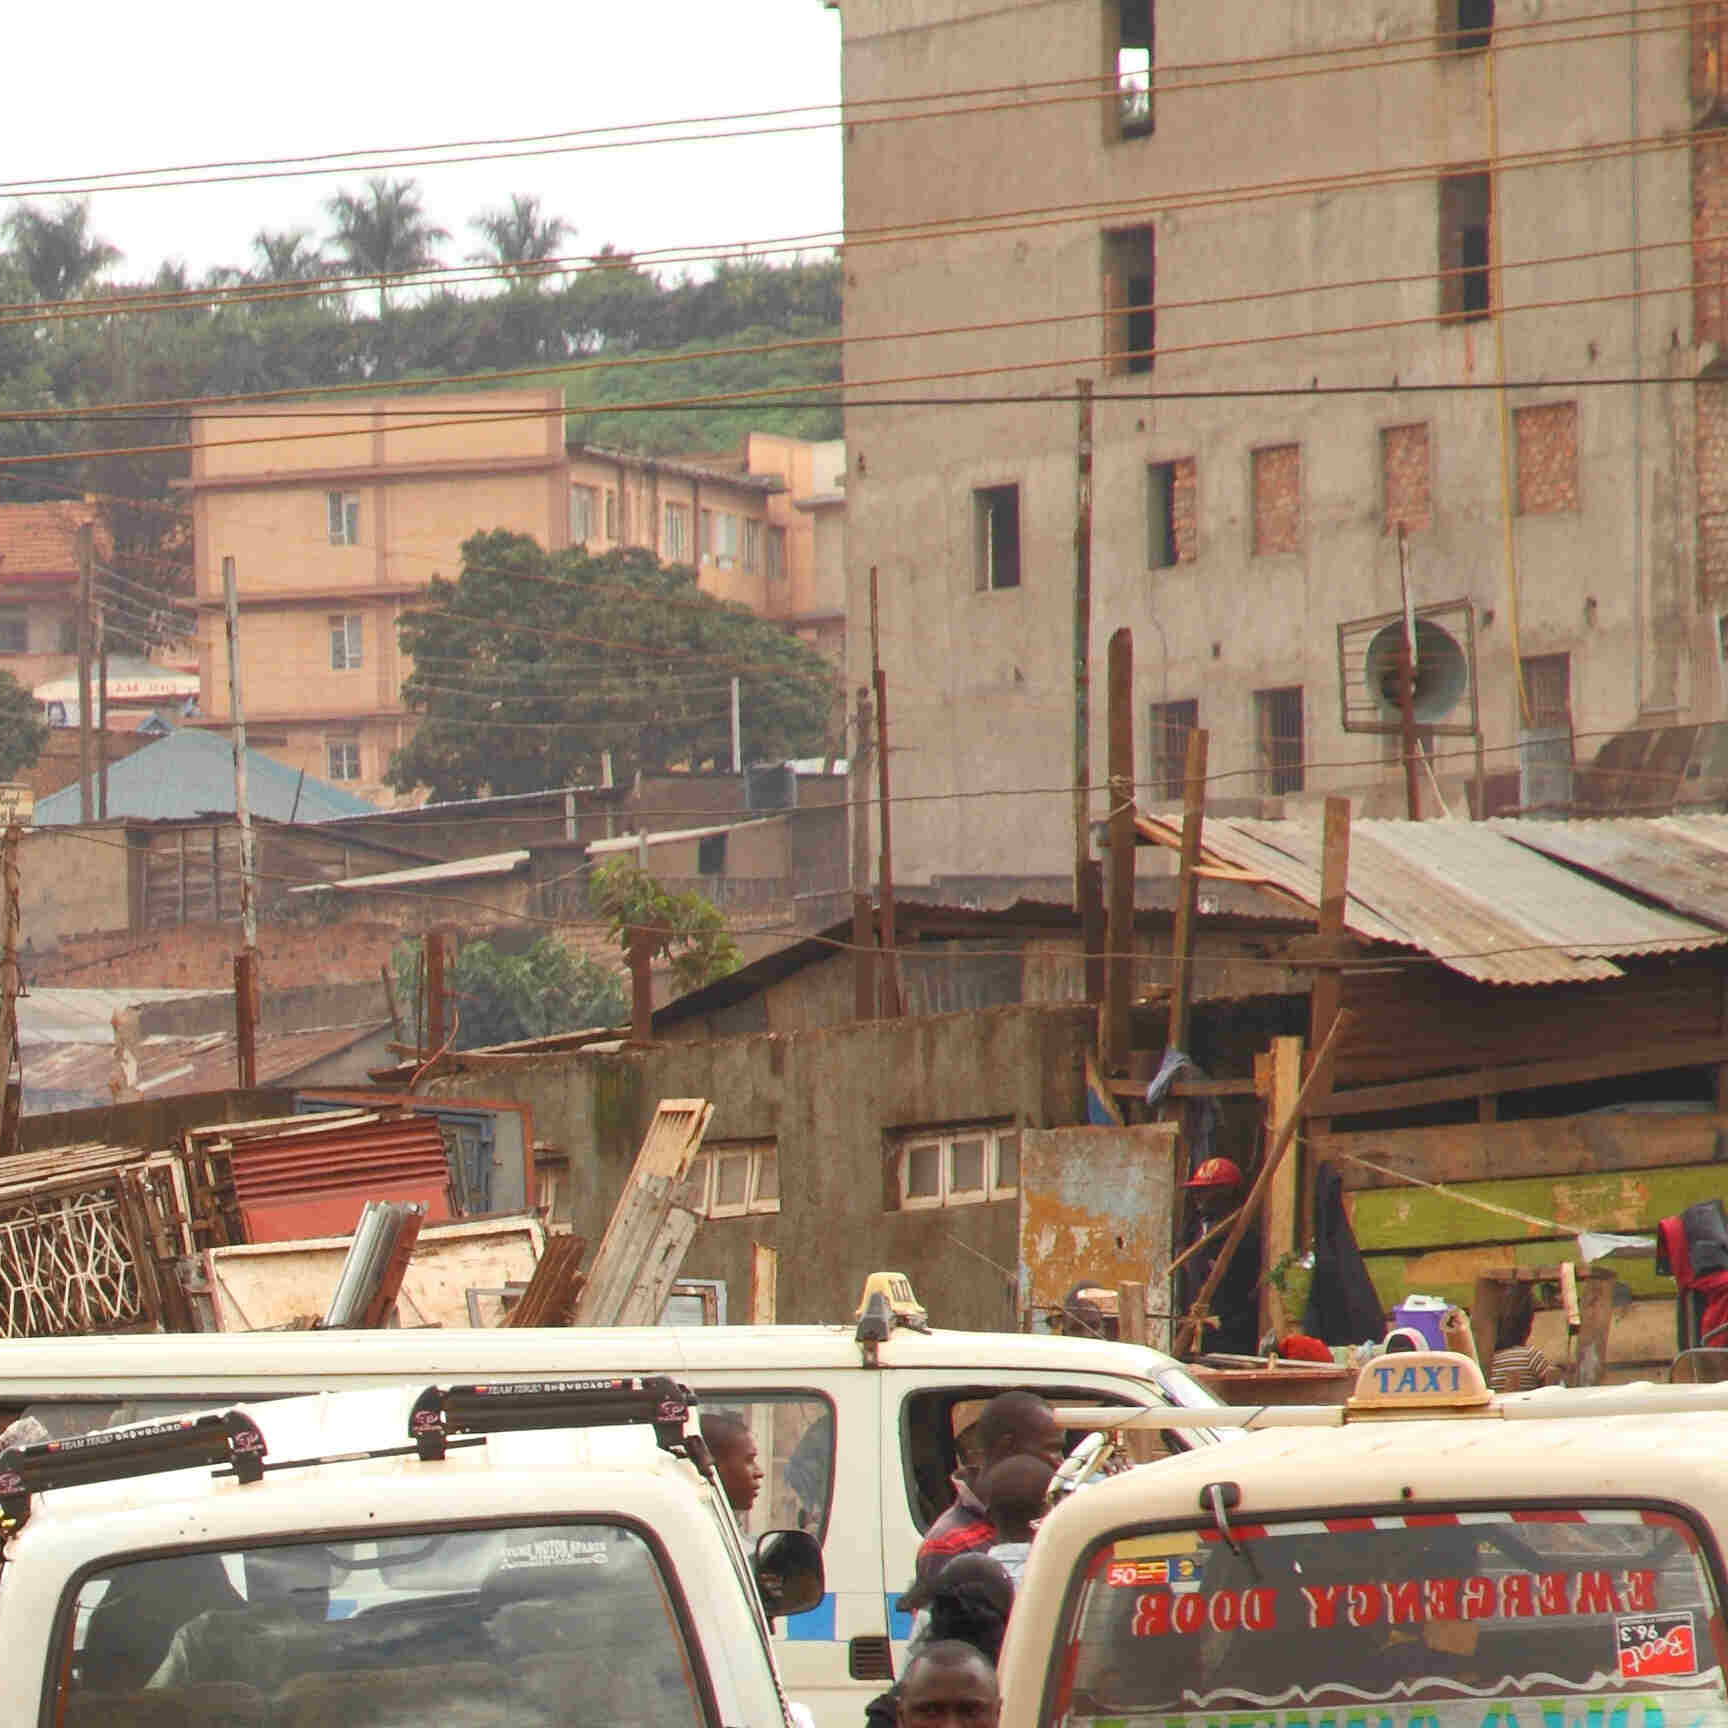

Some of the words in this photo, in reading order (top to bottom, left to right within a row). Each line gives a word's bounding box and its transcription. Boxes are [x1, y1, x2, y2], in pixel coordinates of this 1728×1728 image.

[544, 1381, 611, 1393] SNOWBOARD
[1374, 1366, 1461, 1393] TAXI
[115, 1422, 181, 1441] SNOWBOARD
[1108, 1567, 1136, 1585] 50
